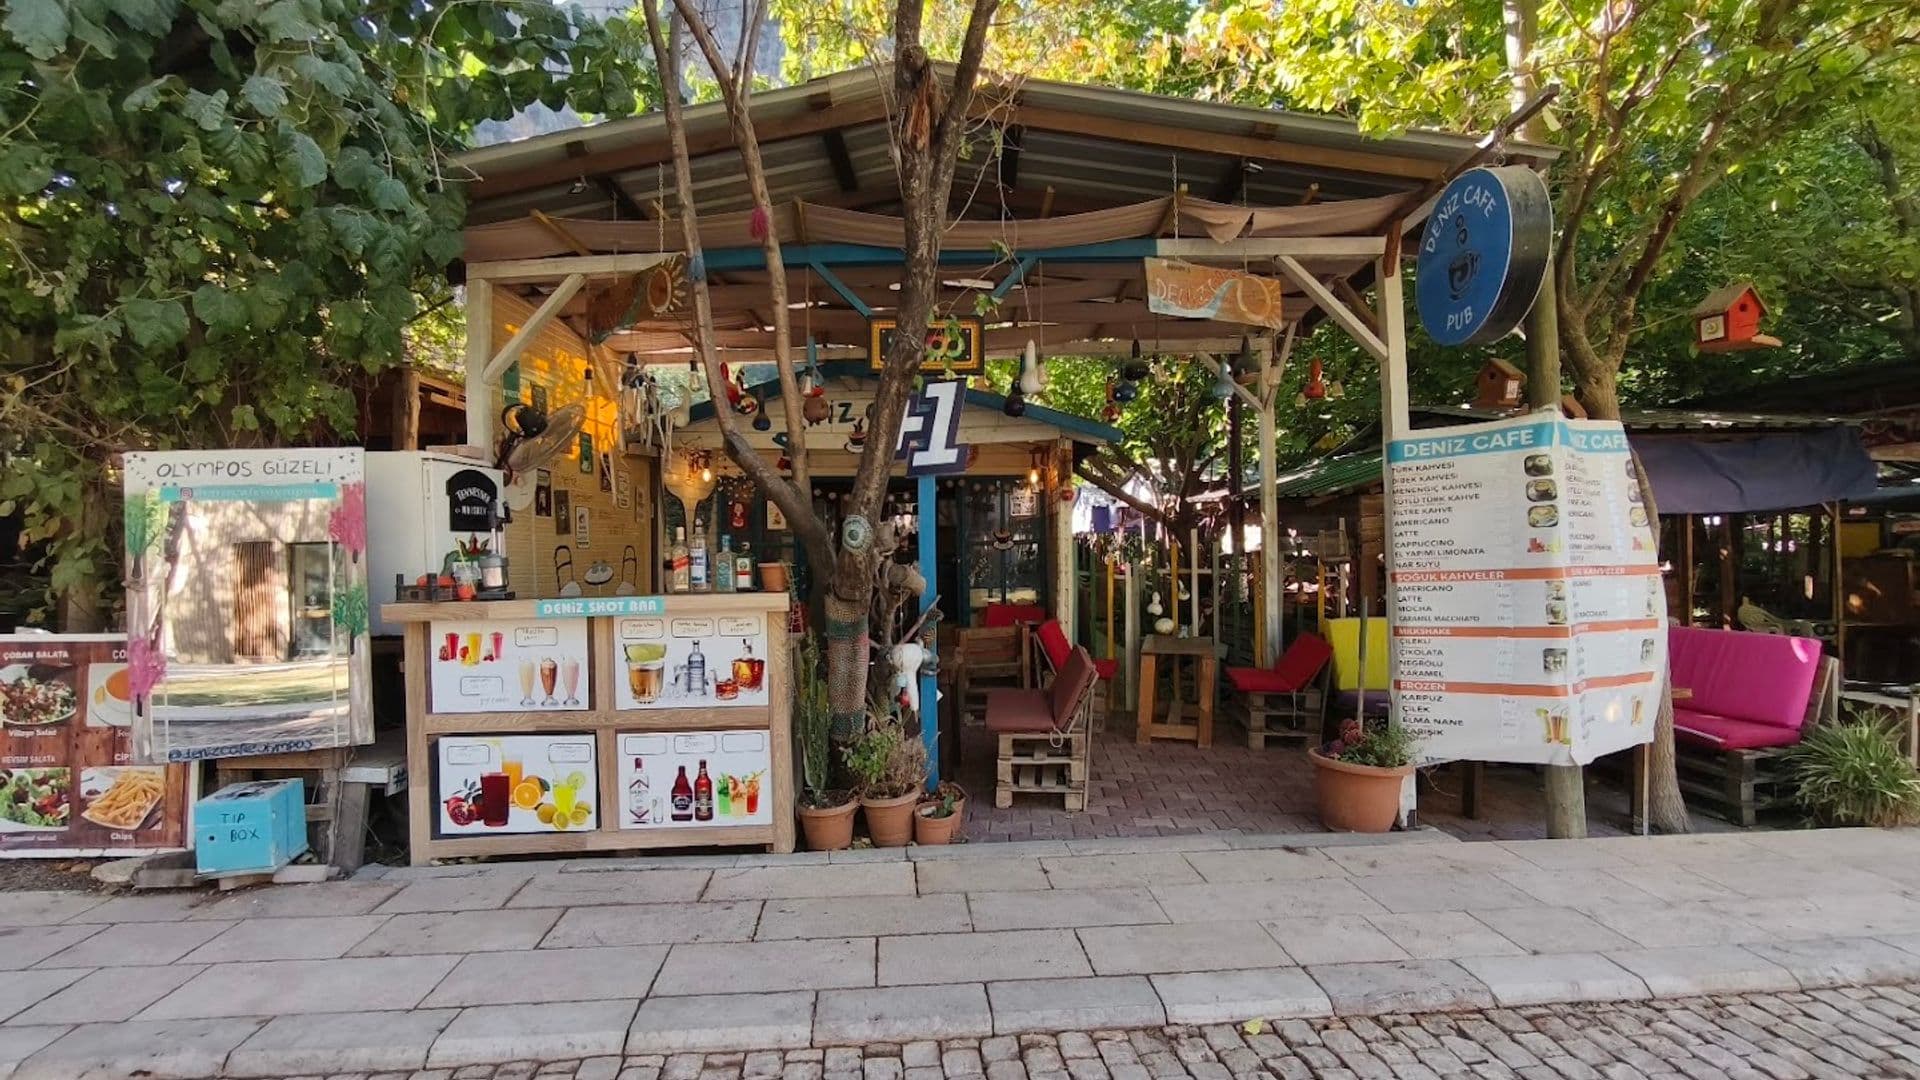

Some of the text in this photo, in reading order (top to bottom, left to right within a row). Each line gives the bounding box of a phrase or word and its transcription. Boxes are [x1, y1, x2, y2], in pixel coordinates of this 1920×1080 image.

[1463, 184, 1497, 218] CAFE
[1446, 306, 1473, 331] PUB
[1472, 429, 1534, 450] CAFE
[156, 460, 252, 477] OLYMPOS
[1448, 493, 1480, 502] KAHVE
[1394, 530, 1419, 538] LATTE
[1394, 539, 1455, 549] CAPPUCCINO
[1440, 570, 1505, 581] KAHVELER
[588, 601, 625, 612] SHOT
[630, 600, 657, 612] BAR
[36, 650, 69, 659] SALATA
[1400, 681, 1446, 691] FROZEN
[1401, 694, 1445, 702] KARPUZ
[1433, 718, 1465, 726] NANE
[220, 813, 246, 824] TIP
[110, 832, 133, 841] Chips
[230, 829, 260, 842] BOX
